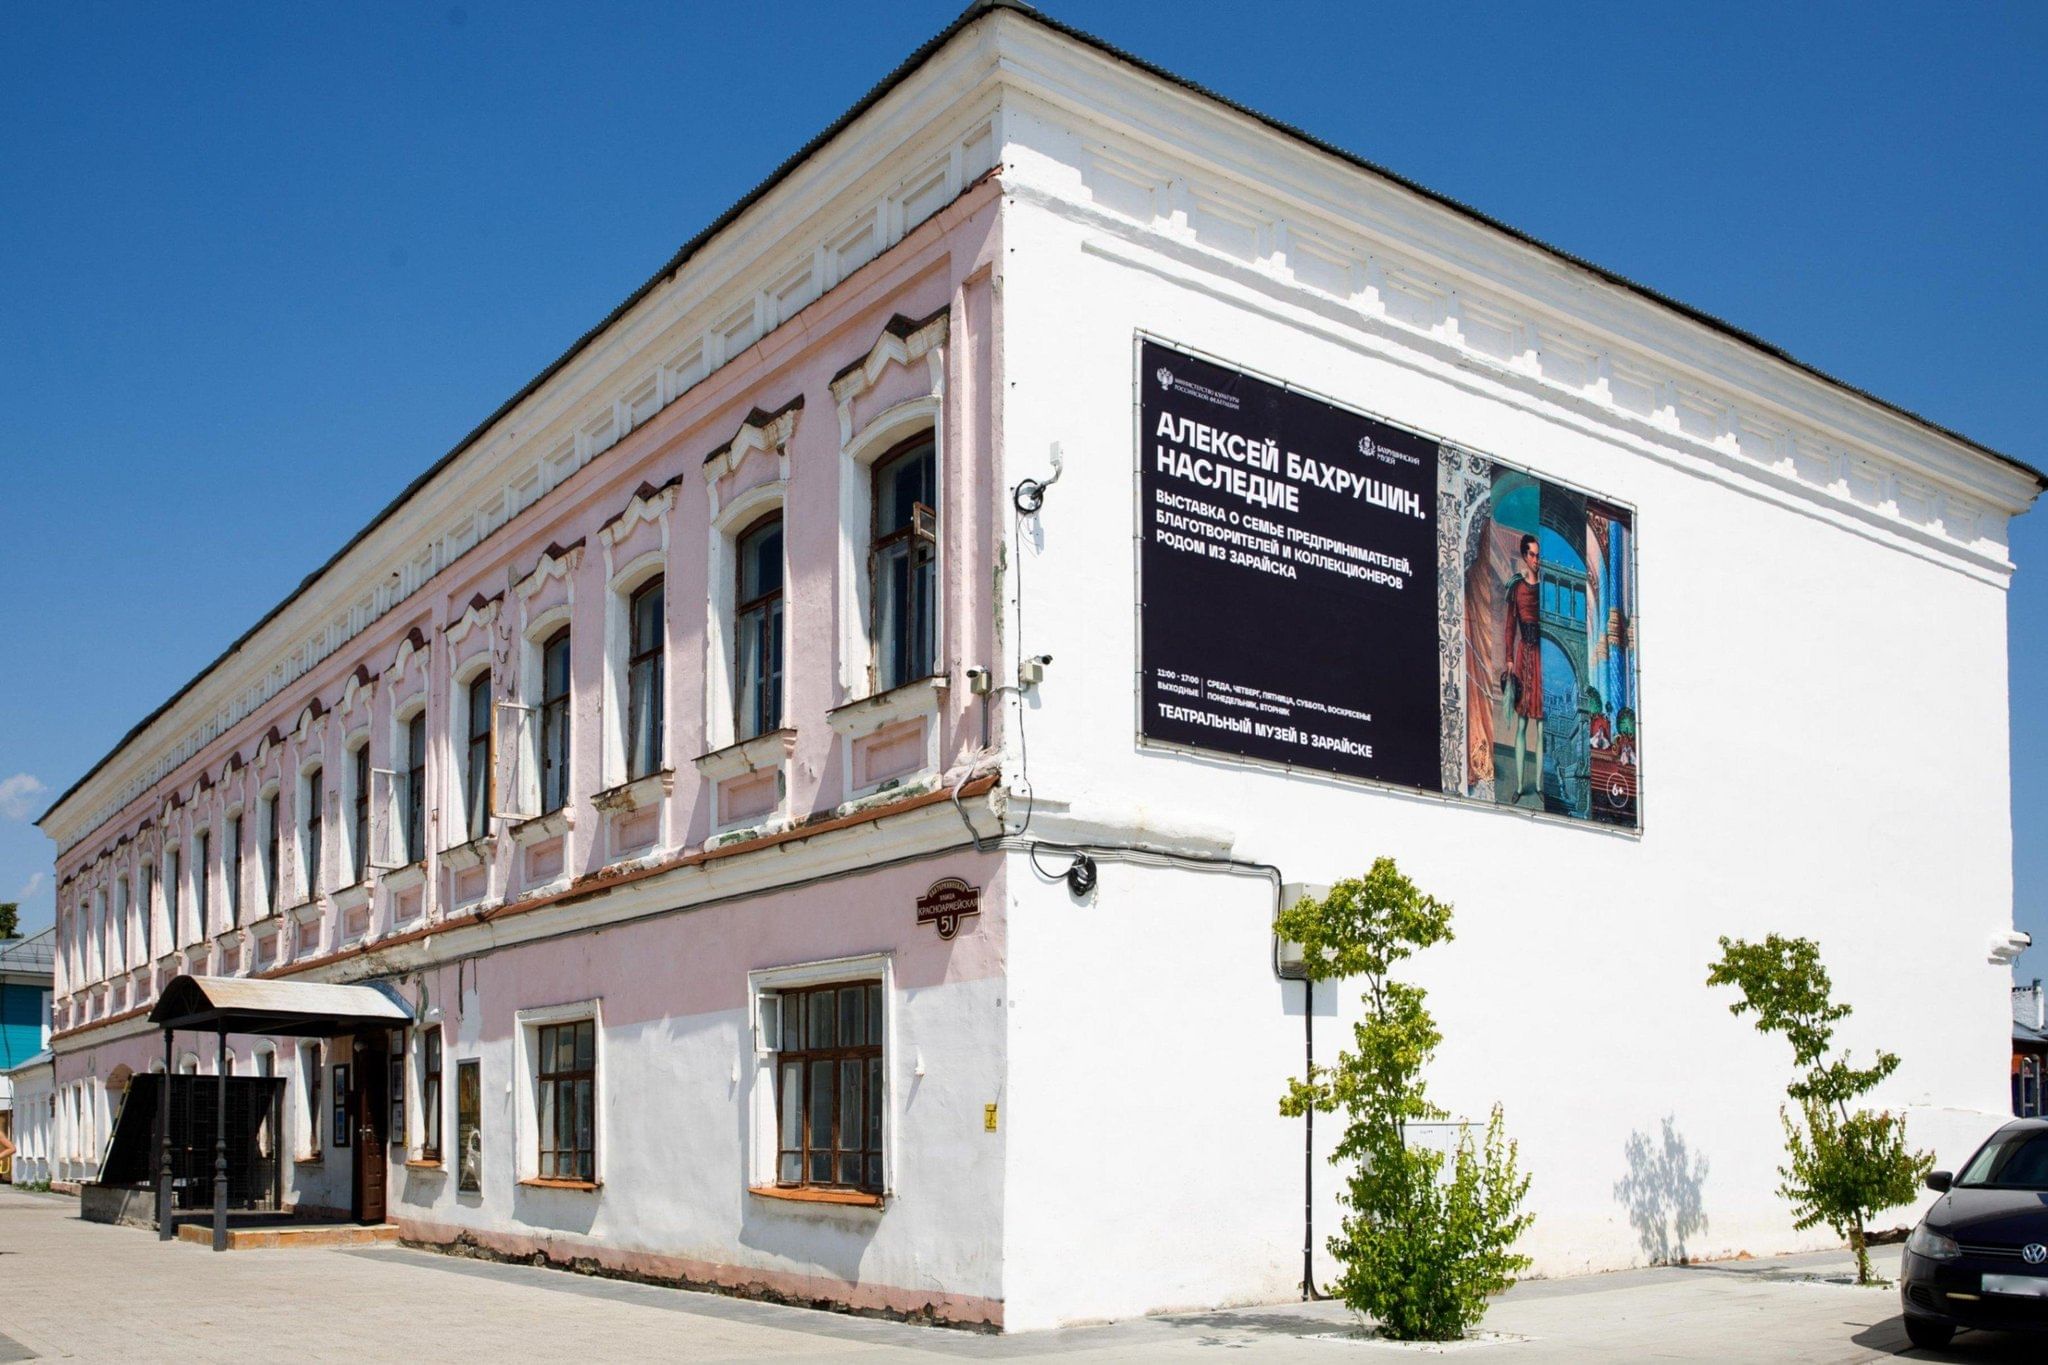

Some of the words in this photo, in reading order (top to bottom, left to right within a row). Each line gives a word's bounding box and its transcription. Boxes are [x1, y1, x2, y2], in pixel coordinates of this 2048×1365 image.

[1156, 411, 1279, 474] АЛЕКСЕЙ
[1286, 451, 1426, 520] БАХРУШИН.
[1157, 445, 1300, 513] НАСЛЕДИЕ
[1156, 489, 1226, 522] ВЫСТАВКА
[1229, 511, 1240, 524] О
[1242, 514, 1284, 538] СЕМЬЕ
[1287, 527, 1413, 577] ПРЕДПРИНИМАТЕЛЕЙ,
[1156, 509, 1280, 558] БЛАГОТВОРИТЕЛЕЙ
[1282, 544, 1292, 559] И
[1294, 548, 1403, 590] КОЛЛЕКЦИОНЕРОВ
[1156, 529, 1205, 555] РОДОМ
[1208, 543, 1226, 560] ИЗ
[1229, 548, 1297, 580] ЗАРАЙСКА
[1157, 668, 1176, 679] 11:00
[1180, 674, 1199, 684] 17:00
[1157, 681, 1200, 698] ВЫХОДНЫЕ
[1206, 679, 1232, 692] СРЕДА,
[1233, 685, 1262, 699] ЧЕТВЕРГ,
[1262, 691, 1295, 706] ПЯТНИЦА,
[1296, 698, 1327, 713] СУББОТА,
[1327, 705, 1372, 721] ВОСКРЕСЕНЬЕ
[1206, 692, 1259, 711] ПОНЕДЕЛЬНИК,
[1260, 703, 1290, 716] ВТОРНИК
[1158, 703, 1252, 735] ТЕАТРАЛЬНЫЙ
[1255, 722, 1298, 743] МУЗЕЙ
[1300, 733, 1309, 745] В
[1311, 735, 1373, 759] ЗАРАЙСКЕ
[1611, 783, 1624, 797] 6+
[941, 915, 954, 932] 51
